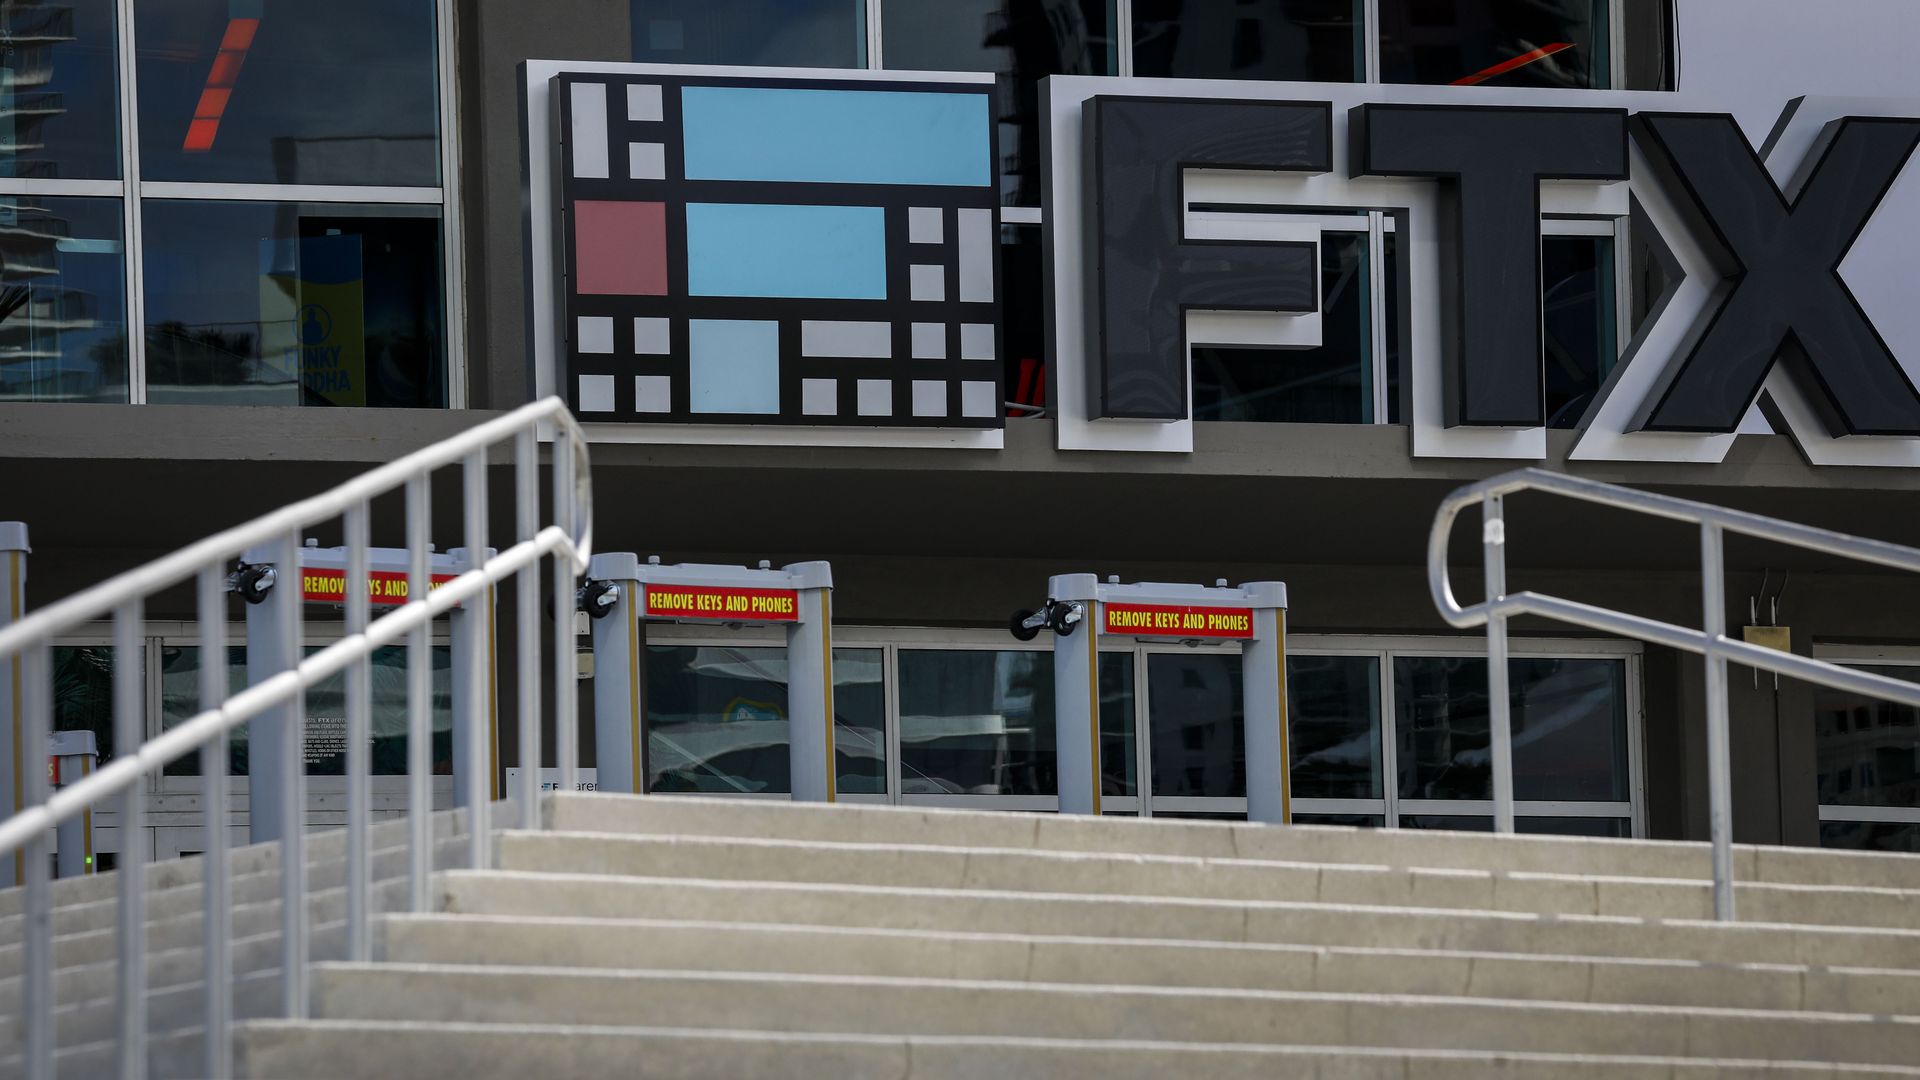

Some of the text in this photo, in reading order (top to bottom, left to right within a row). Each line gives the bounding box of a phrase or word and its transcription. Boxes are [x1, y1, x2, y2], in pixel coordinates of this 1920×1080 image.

[1082, 93, 1920, 437] FTX
[302, 369, 352, 392] DDHA
[304, 575, 349, 595] REMOV
[368, 579, 381, 596] YS
[385, 580, 408, 597] AND
[649, 592, 793, 613] REMOVE KEYS AND PHONES
[1109, 611, 1249, 631] REMOVE KEYS AND PHONES
